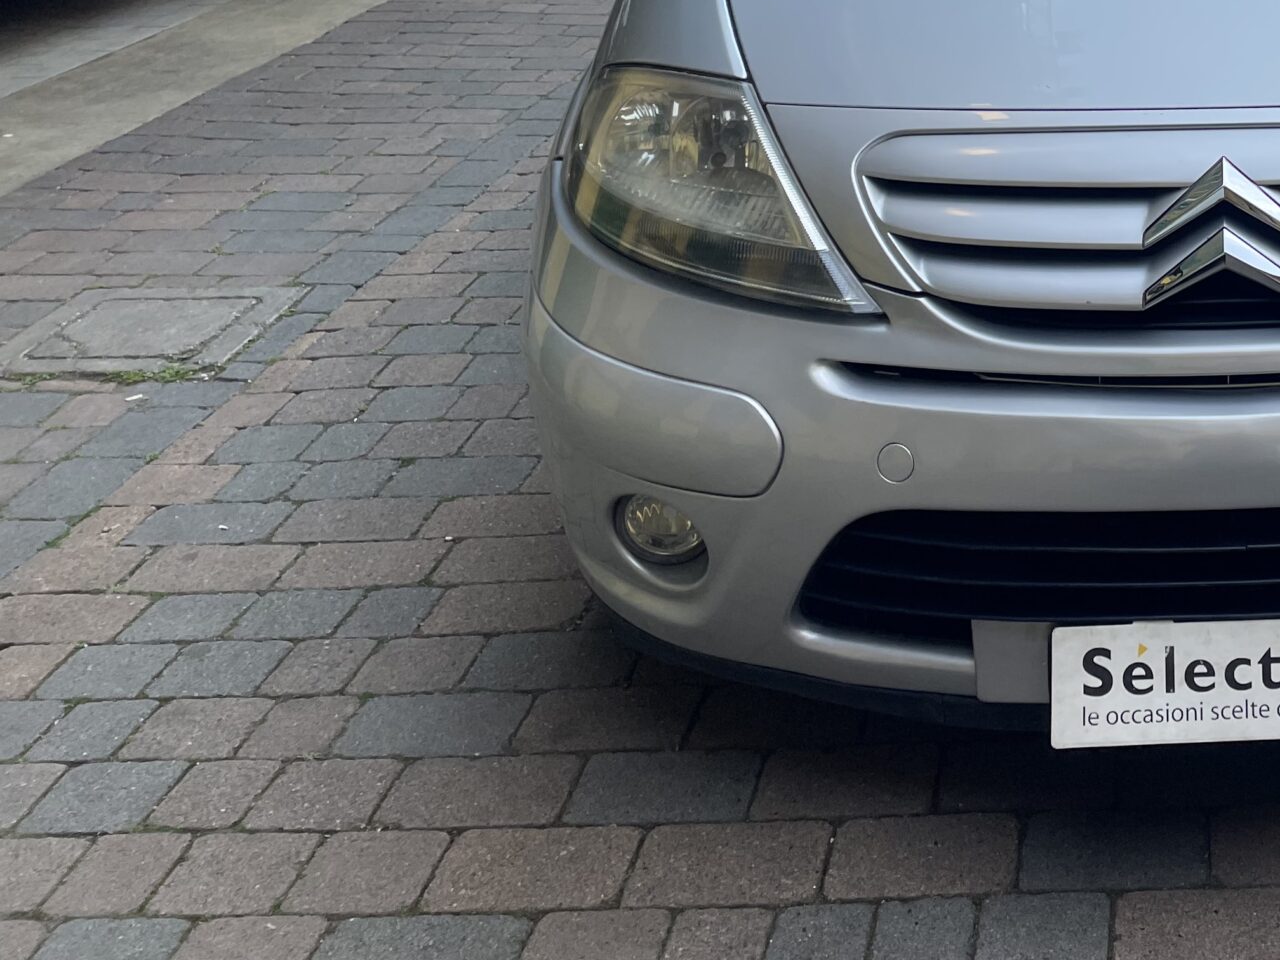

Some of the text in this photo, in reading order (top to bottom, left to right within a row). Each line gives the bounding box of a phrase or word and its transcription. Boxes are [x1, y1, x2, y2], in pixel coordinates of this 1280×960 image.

[1082, 706, 1100, 726] le
[1106, 702, 1204, 725] occasioni
[1211, 699, 1270, 721] scelte
